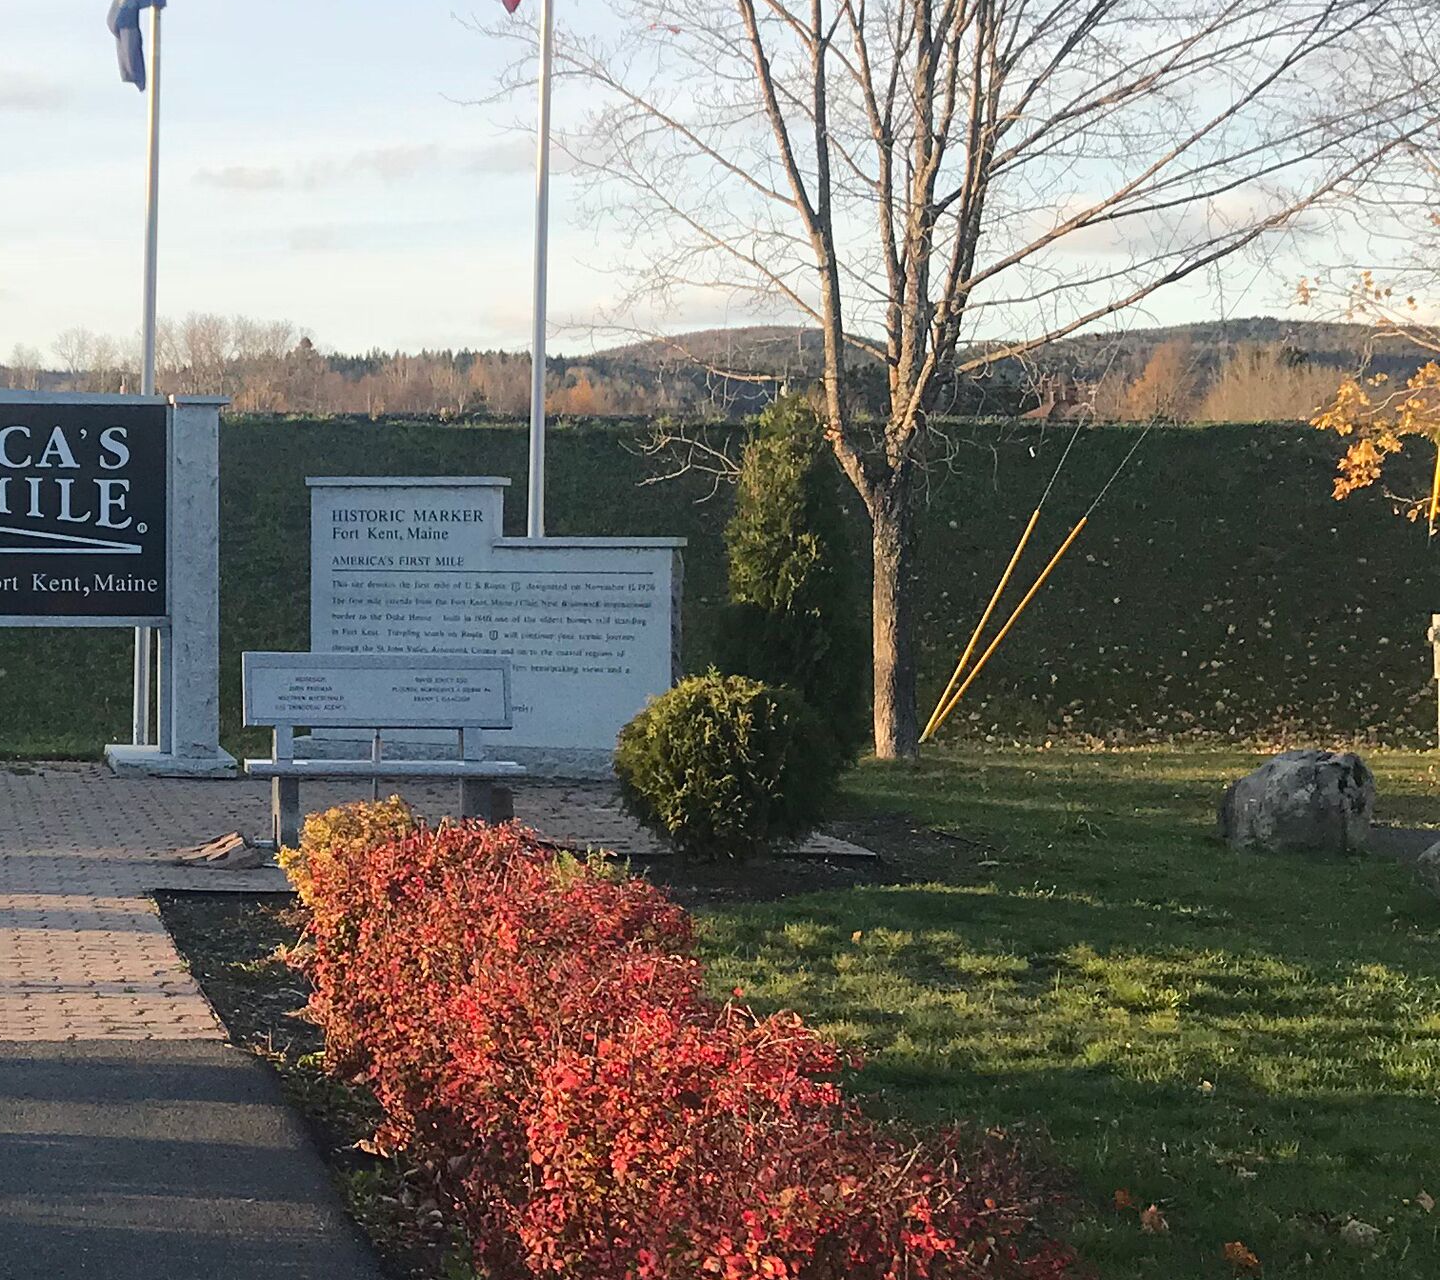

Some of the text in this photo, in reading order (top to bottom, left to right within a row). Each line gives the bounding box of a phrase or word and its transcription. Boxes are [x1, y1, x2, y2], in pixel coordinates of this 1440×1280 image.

[331, 509, 484, 524] HISTORIC MARKER
[332, 526, 449, 541] Fort Kent, Maine
[331, 555, 465, 567] AMERICA'S FIRST MILE
[94, 573, 159, 594] Maine
